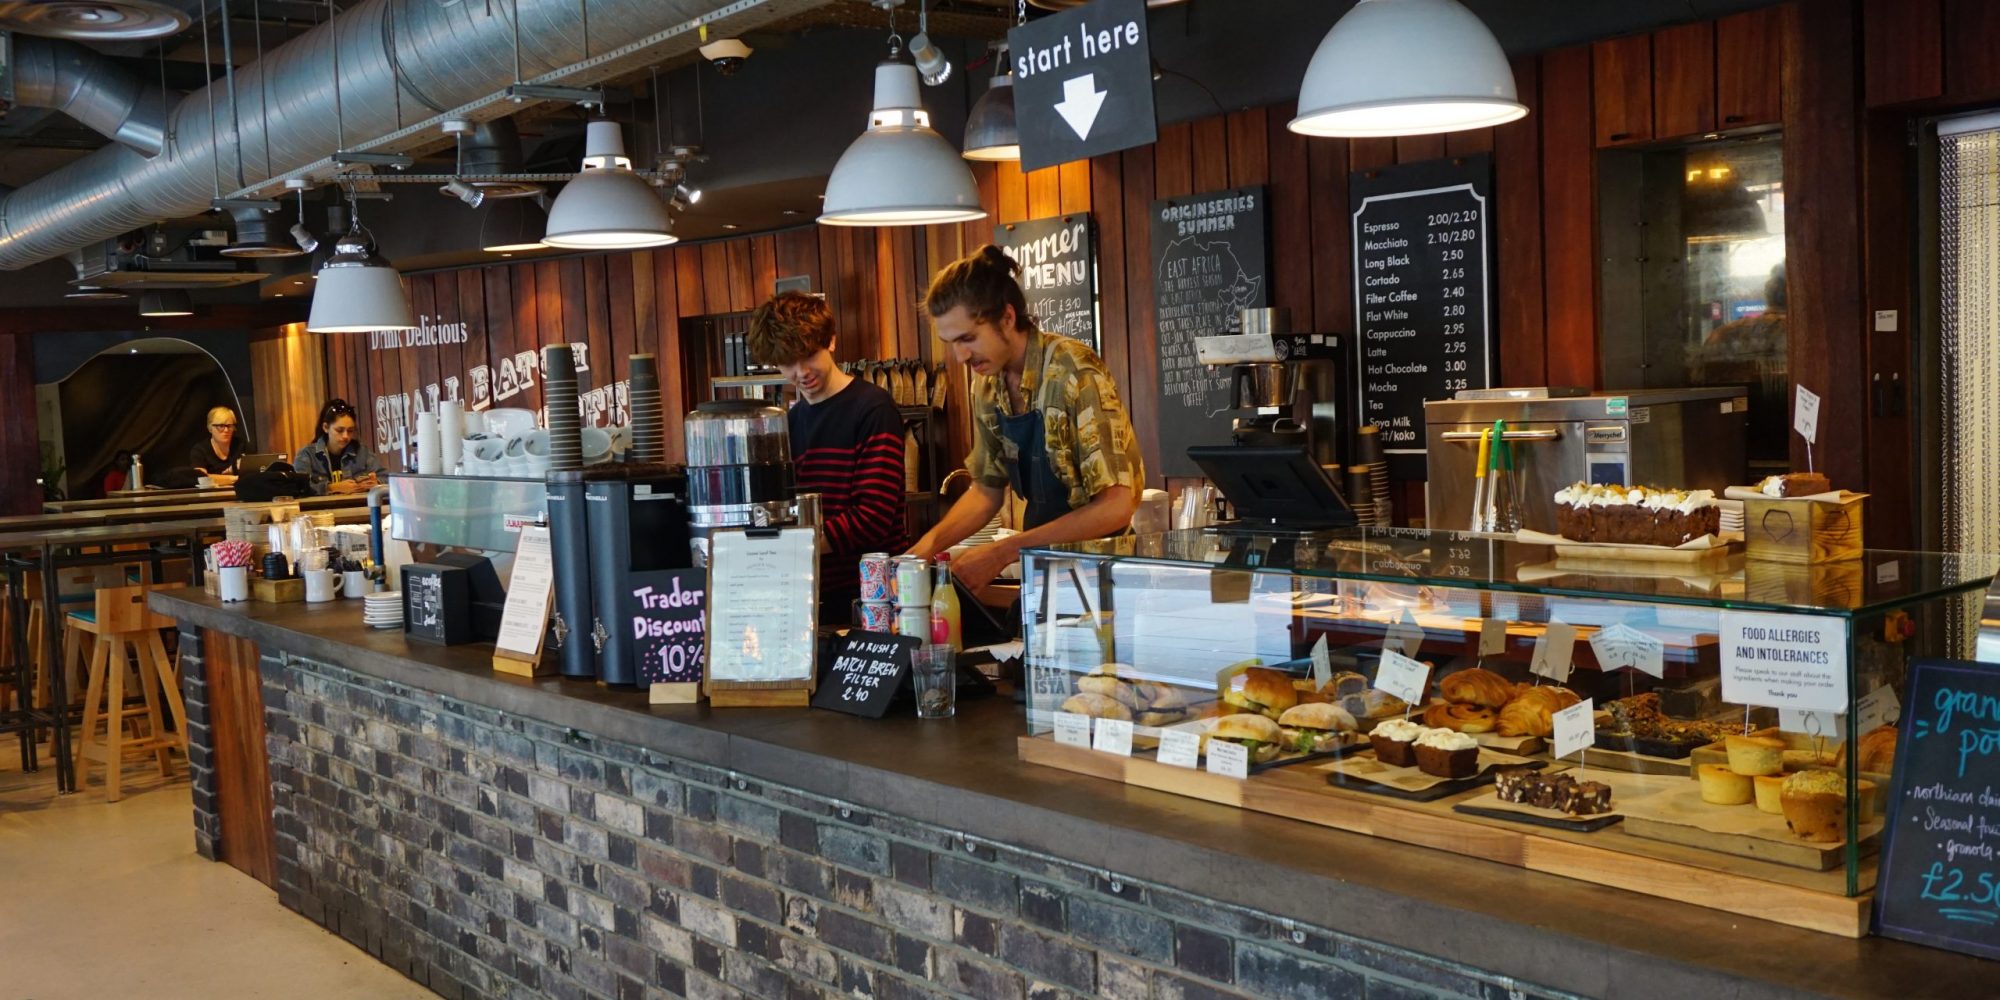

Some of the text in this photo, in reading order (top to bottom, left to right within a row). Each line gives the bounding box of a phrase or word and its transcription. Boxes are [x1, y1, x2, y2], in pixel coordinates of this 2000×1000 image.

[1018, 21, 1140, 79] start here
[1178, 214, 1235, 236] SUMMER
[1363, 222, 1400, 235] Espresso
[1364, 229, 1476, 251] Macchiato 2.10/2.80
[1167, 253, 1221, 279] EAST AFRICA
[1364, 249, 1464, 270] Long Black 2.50
[1024, 259, 1086, 290] MENU
[1365, 268, 1465, 286] Cortado 2.65
[1365, 286, 1465, 304] Filter Coffee 2.40
[1366, 305, 1466, 322] Flat White 2.80
[405, 315, 468, 348] Delicious
[1366, 323, 1465, 341] Cappuccino 2.95
[1367, 342, 1467, 357] Latte 2.95
[1368, 360, 1467, 375] Hot Chocolate 3.00
[1164, 381, 1192, 397] DELICIOUS
[1368, 379, 1468, 392] Mocha 3.25
[1368, 400, 1384, 410] Tea
[1369, 416, 1411, 430] Soya Milk
[1593, 431, 1623, 440] Merrychef
[633, 576, 705, 610] Trader
[633, 609, 706, 640] Discount
[1742, 627, 1821, 644] FOOD ALLERGIES
[847, 640, 859, 651] IN
[857, 641, 866, 652] A
[866, 642, 890, 653] RUSH
[1735, 646, 1829, 665] AND INTOLERANCES
[657, 643, 705, 675] 10%
[832, 655, 900, 677] BATCH BREW
[842, 672, 880, 689] FILTER
[1754, 668, 1770, 676] speak
[1034, 680, 1066, 694] ISTA
[1780, 678, 1802, 687] making
[1768, 689, 1785, 697] Thank
[1934, 686, 2000, 735] gran
[1923, 805, 1974, 834] Seasonal
[1946, 838, 1994, 862] granola
